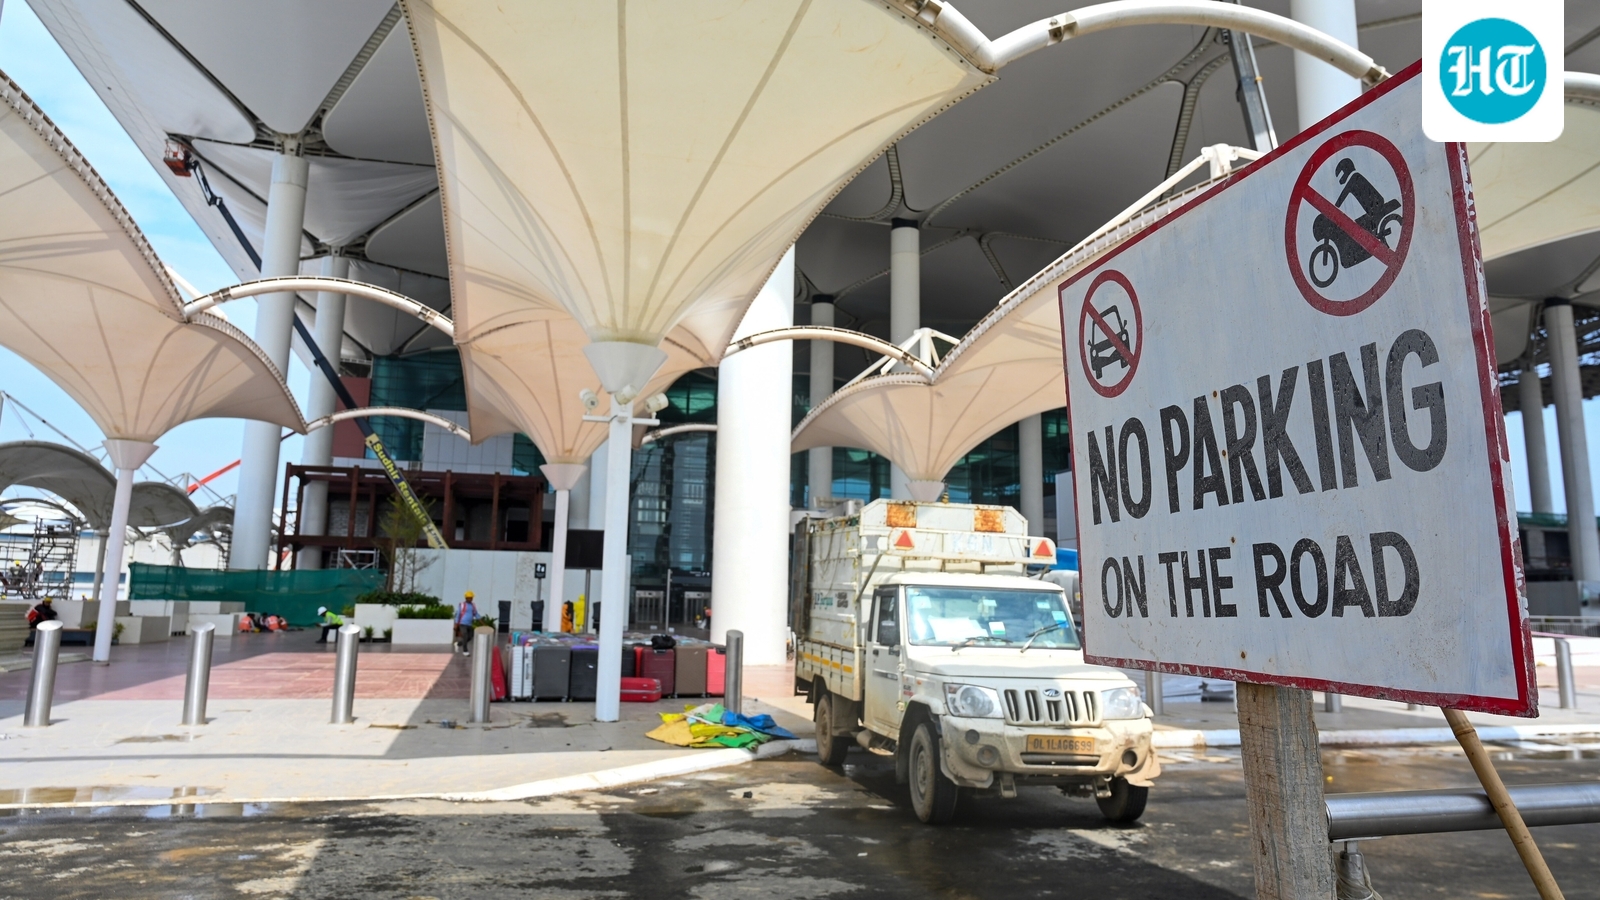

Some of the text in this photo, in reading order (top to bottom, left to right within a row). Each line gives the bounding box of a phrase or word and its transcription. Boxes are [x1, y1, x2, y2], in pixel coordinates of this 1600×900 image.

[1088, 329, 1447, 525] NO PARKING
[373, 443, 427, 525] Sudhir Rentals
[1101, 531, 1420, 619] ON THE ROAD
